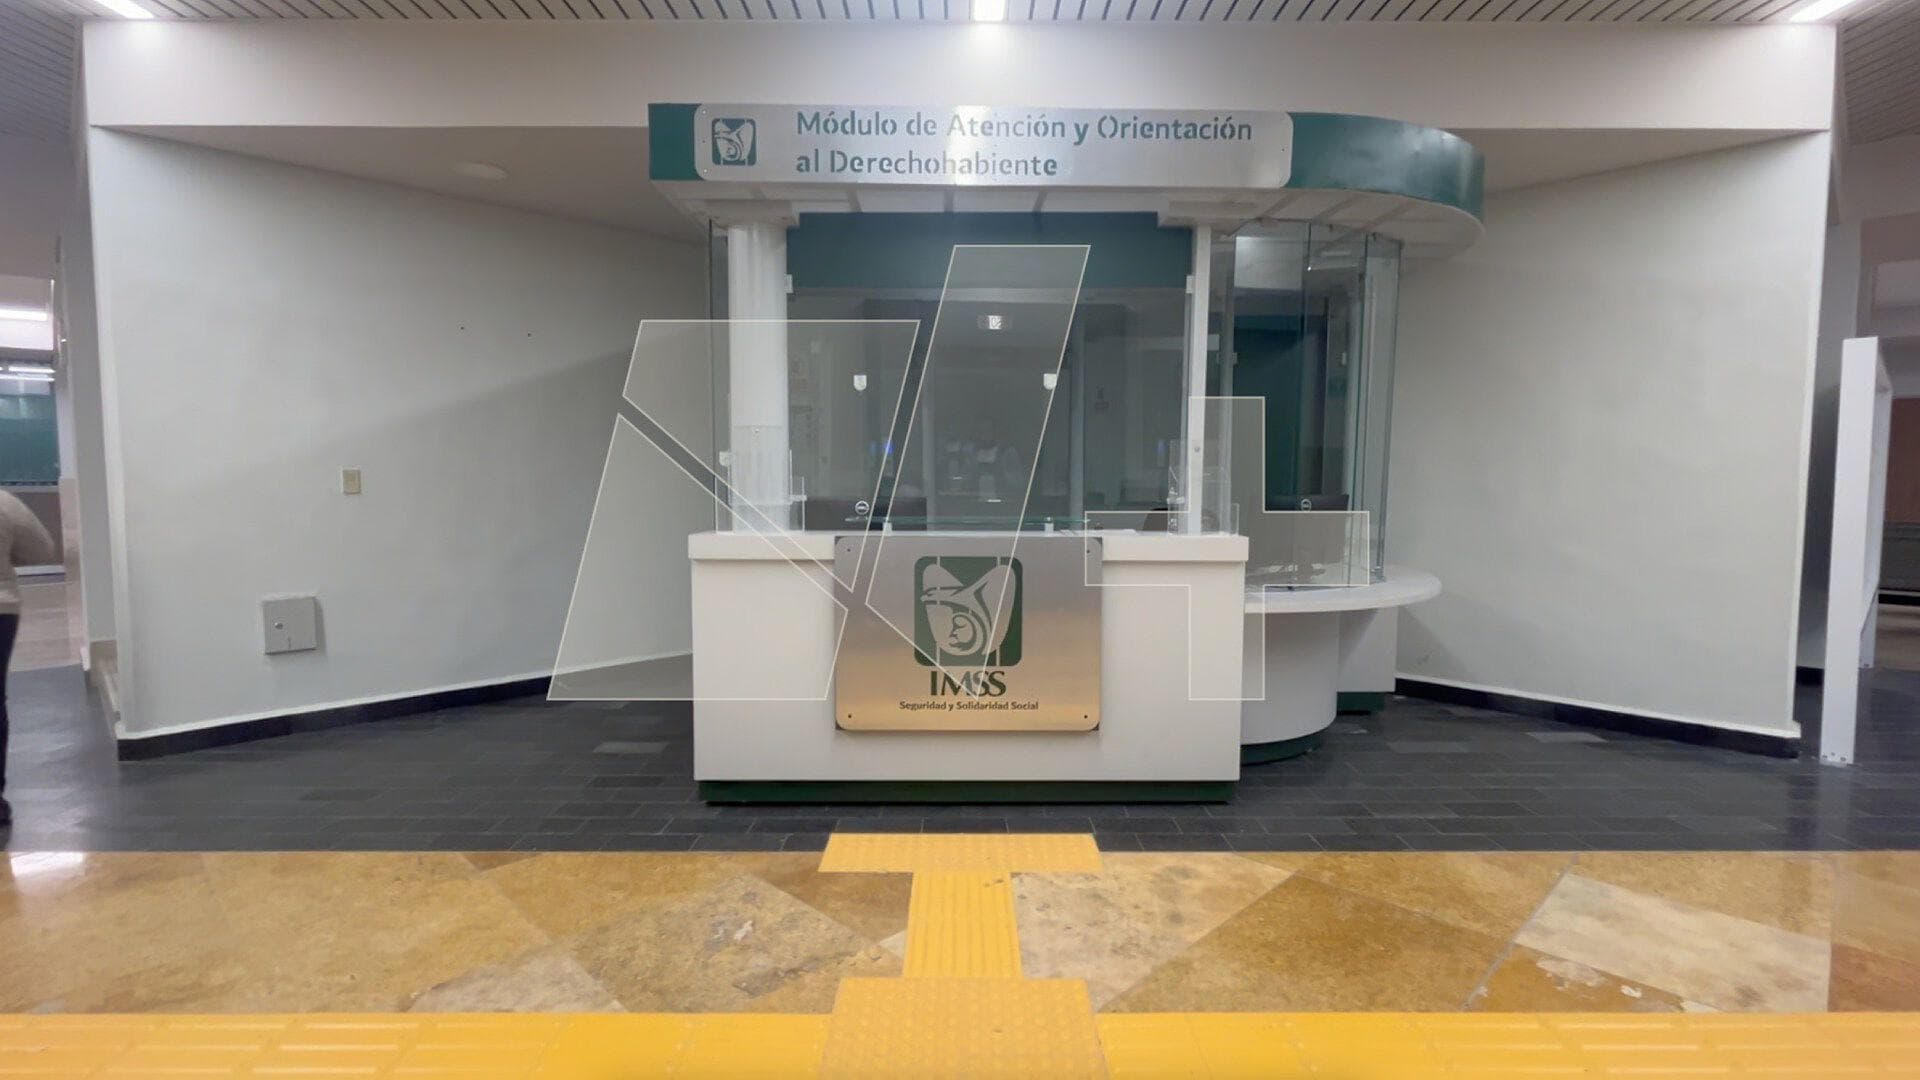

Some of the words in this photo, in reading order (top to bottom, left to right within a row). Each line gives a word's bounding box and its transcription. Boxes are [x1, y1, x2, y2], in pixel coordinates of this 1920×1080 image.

[796, 110, 898, 136] Módulo
[906, 111, 937, 136] de
[946, 114, 1065, 138] Atención
[1073, 122, 1090, 146] y
[1096, 115, 1252, 140] Orientación
[795, 148, 820, 173] al
[830, 149, 1058, 176] Derechohabiente
[930, 670, 1007, 697] IMSS
[899, 701, 947, 711] Seguridad
[948, 702, 954, 712] y
[955, 701, 1009, 711] Solidaridad
[1011, 701, 1039, 711] Social
